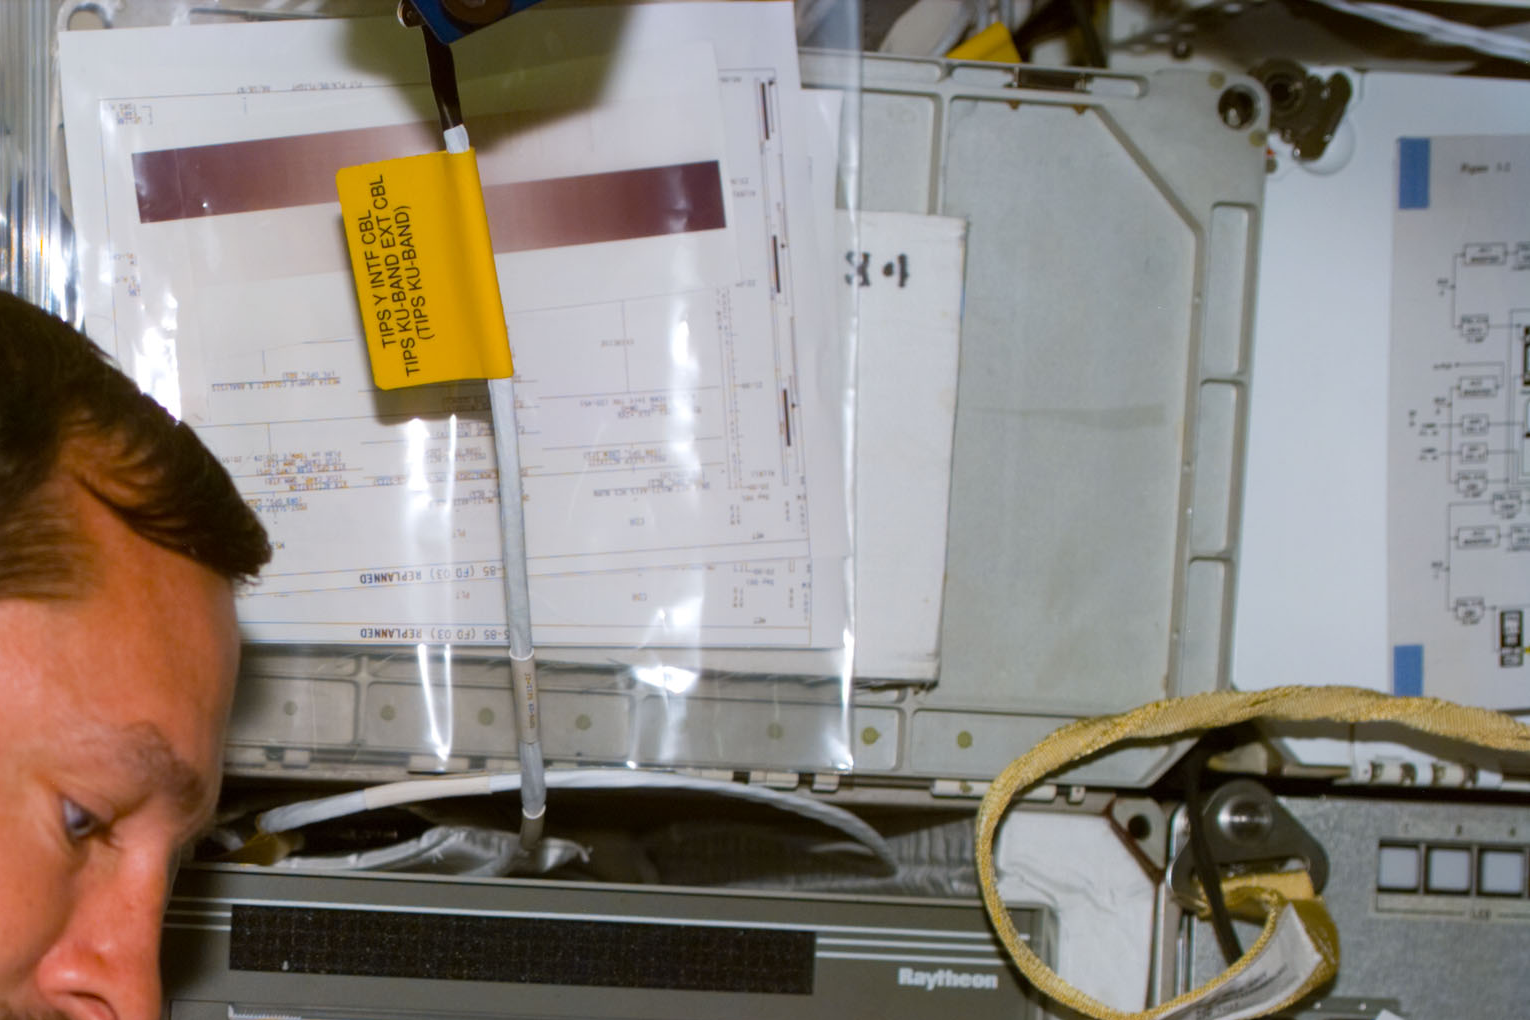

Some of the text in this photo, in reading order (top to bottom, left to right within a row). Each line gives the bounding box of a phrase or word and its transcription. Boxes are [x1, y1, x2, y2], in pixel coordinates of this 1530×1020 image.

[358, 210, 396, 349] TIPS Y INTF CBL
[370, 174, 420, 377] TIPS KU-BAND EXT CBL
[393, 205, 435, 340] (TIPS KU-BAND)
[359, 570, 422, 585] REPLANNED
[360, 627, 423, 640] REPLANNED
[897, 967, 999, 991] Raytheon
